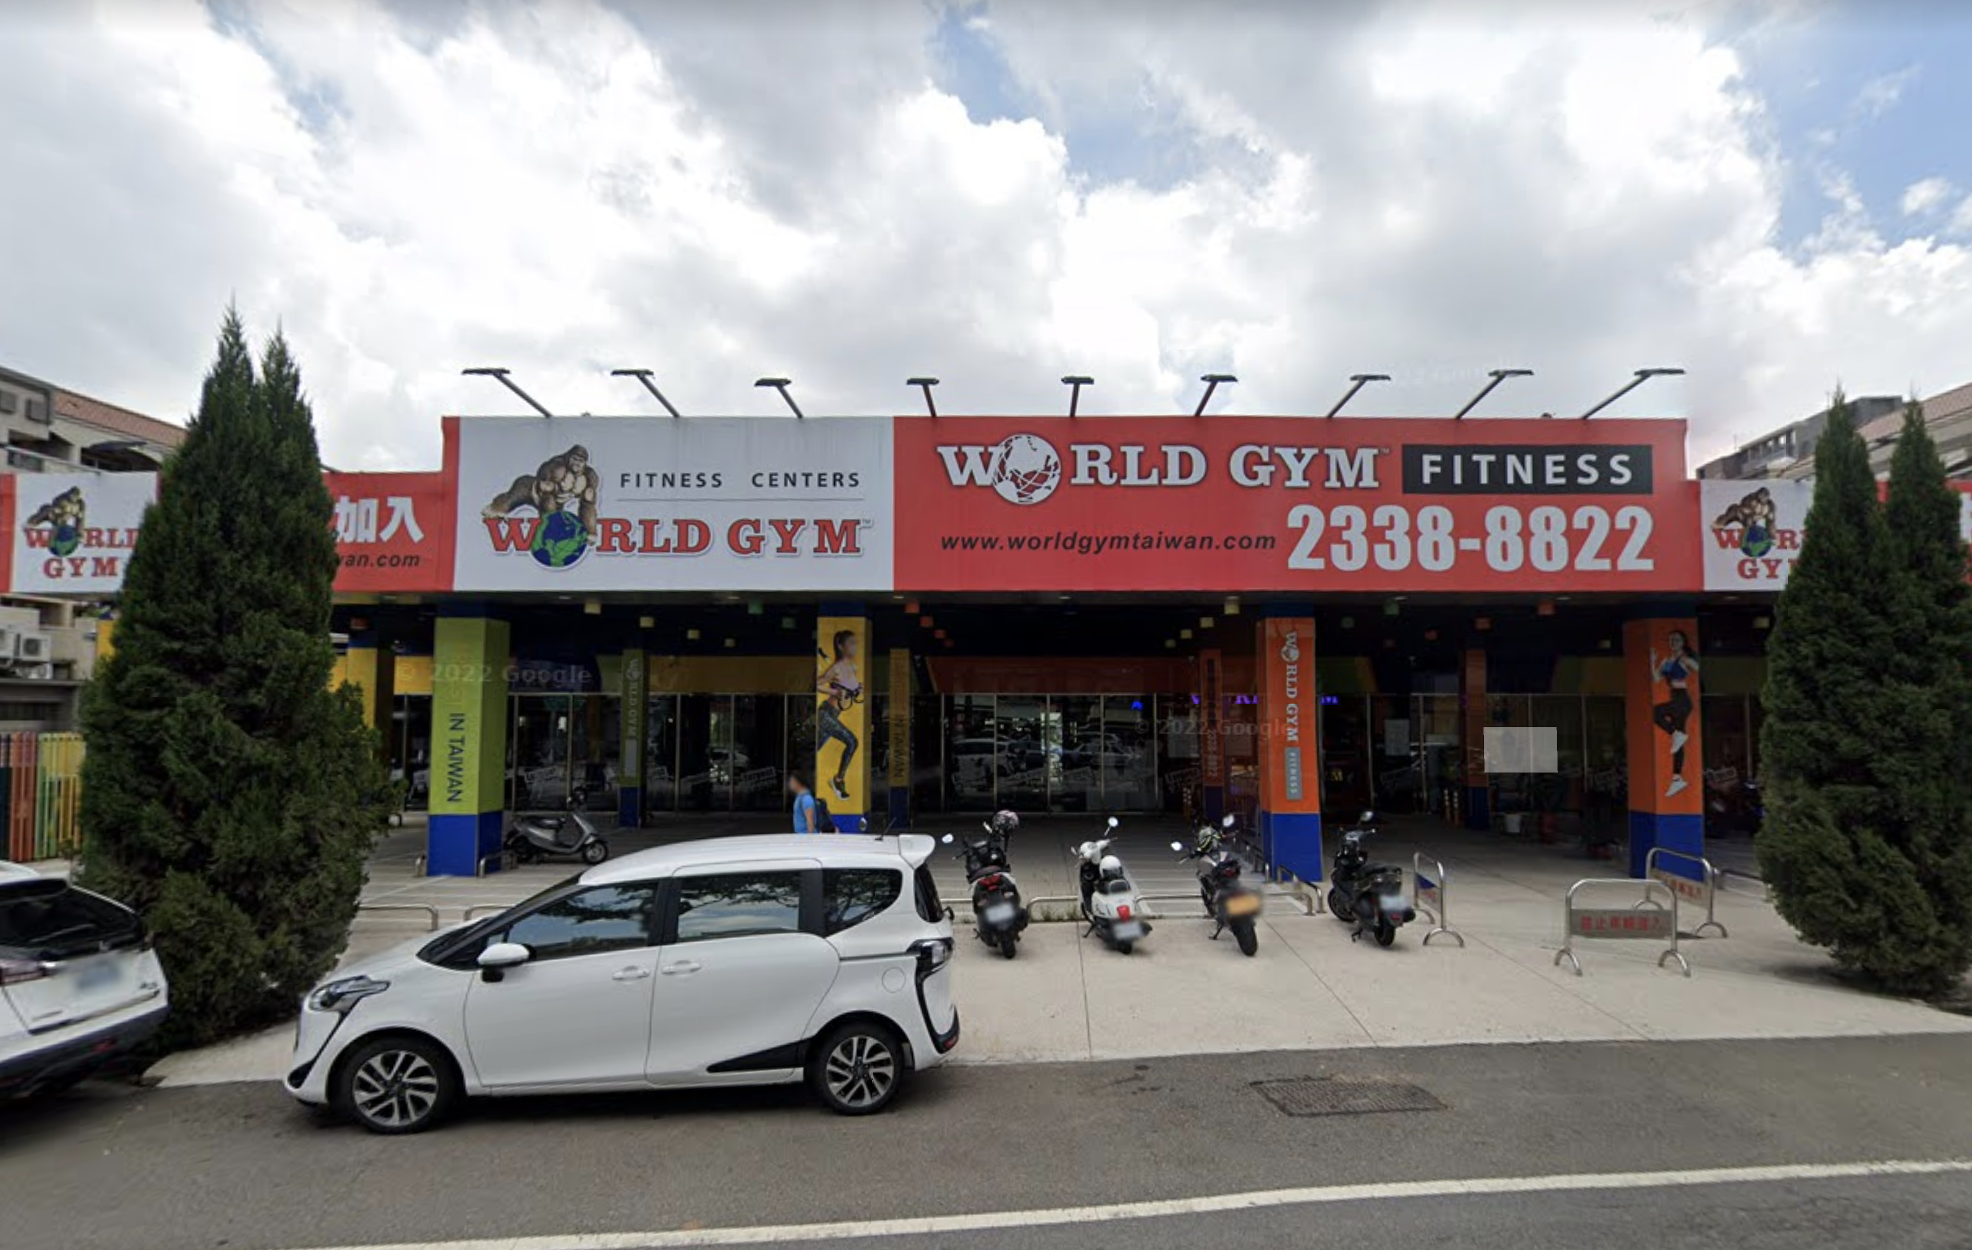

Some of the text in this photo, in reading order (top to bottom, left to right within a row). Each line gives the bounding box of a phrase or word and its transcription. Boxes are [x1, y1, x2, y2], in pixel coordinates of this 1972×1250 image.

[620, 472, 861, 488] FITNESS CENTERS
[937, 433, 1208, 506] WORLD
[1229, 444, 1379, 488] GYM
[1421, 453, 1633, 486] FITNESS
[335, 495, 424, 543] 加入
[482, 511, 712, 568] WORLD
[726, 518, 861, 555] GYM
[941, 531, 1276, 554] www.worldgymtaiwan.com
[1287, 504, 1655, 572] 2338-8822
[1712, 524, 1807, 557] WOR
[43, 557, 119, 579] GYM
[1737, 558, 1800, 579] GY
[1281, 631, 1300, 742] WORLD GYM
[450, 713, 465, 731] IN
[446, 738, 465, 803] TAIWAN
